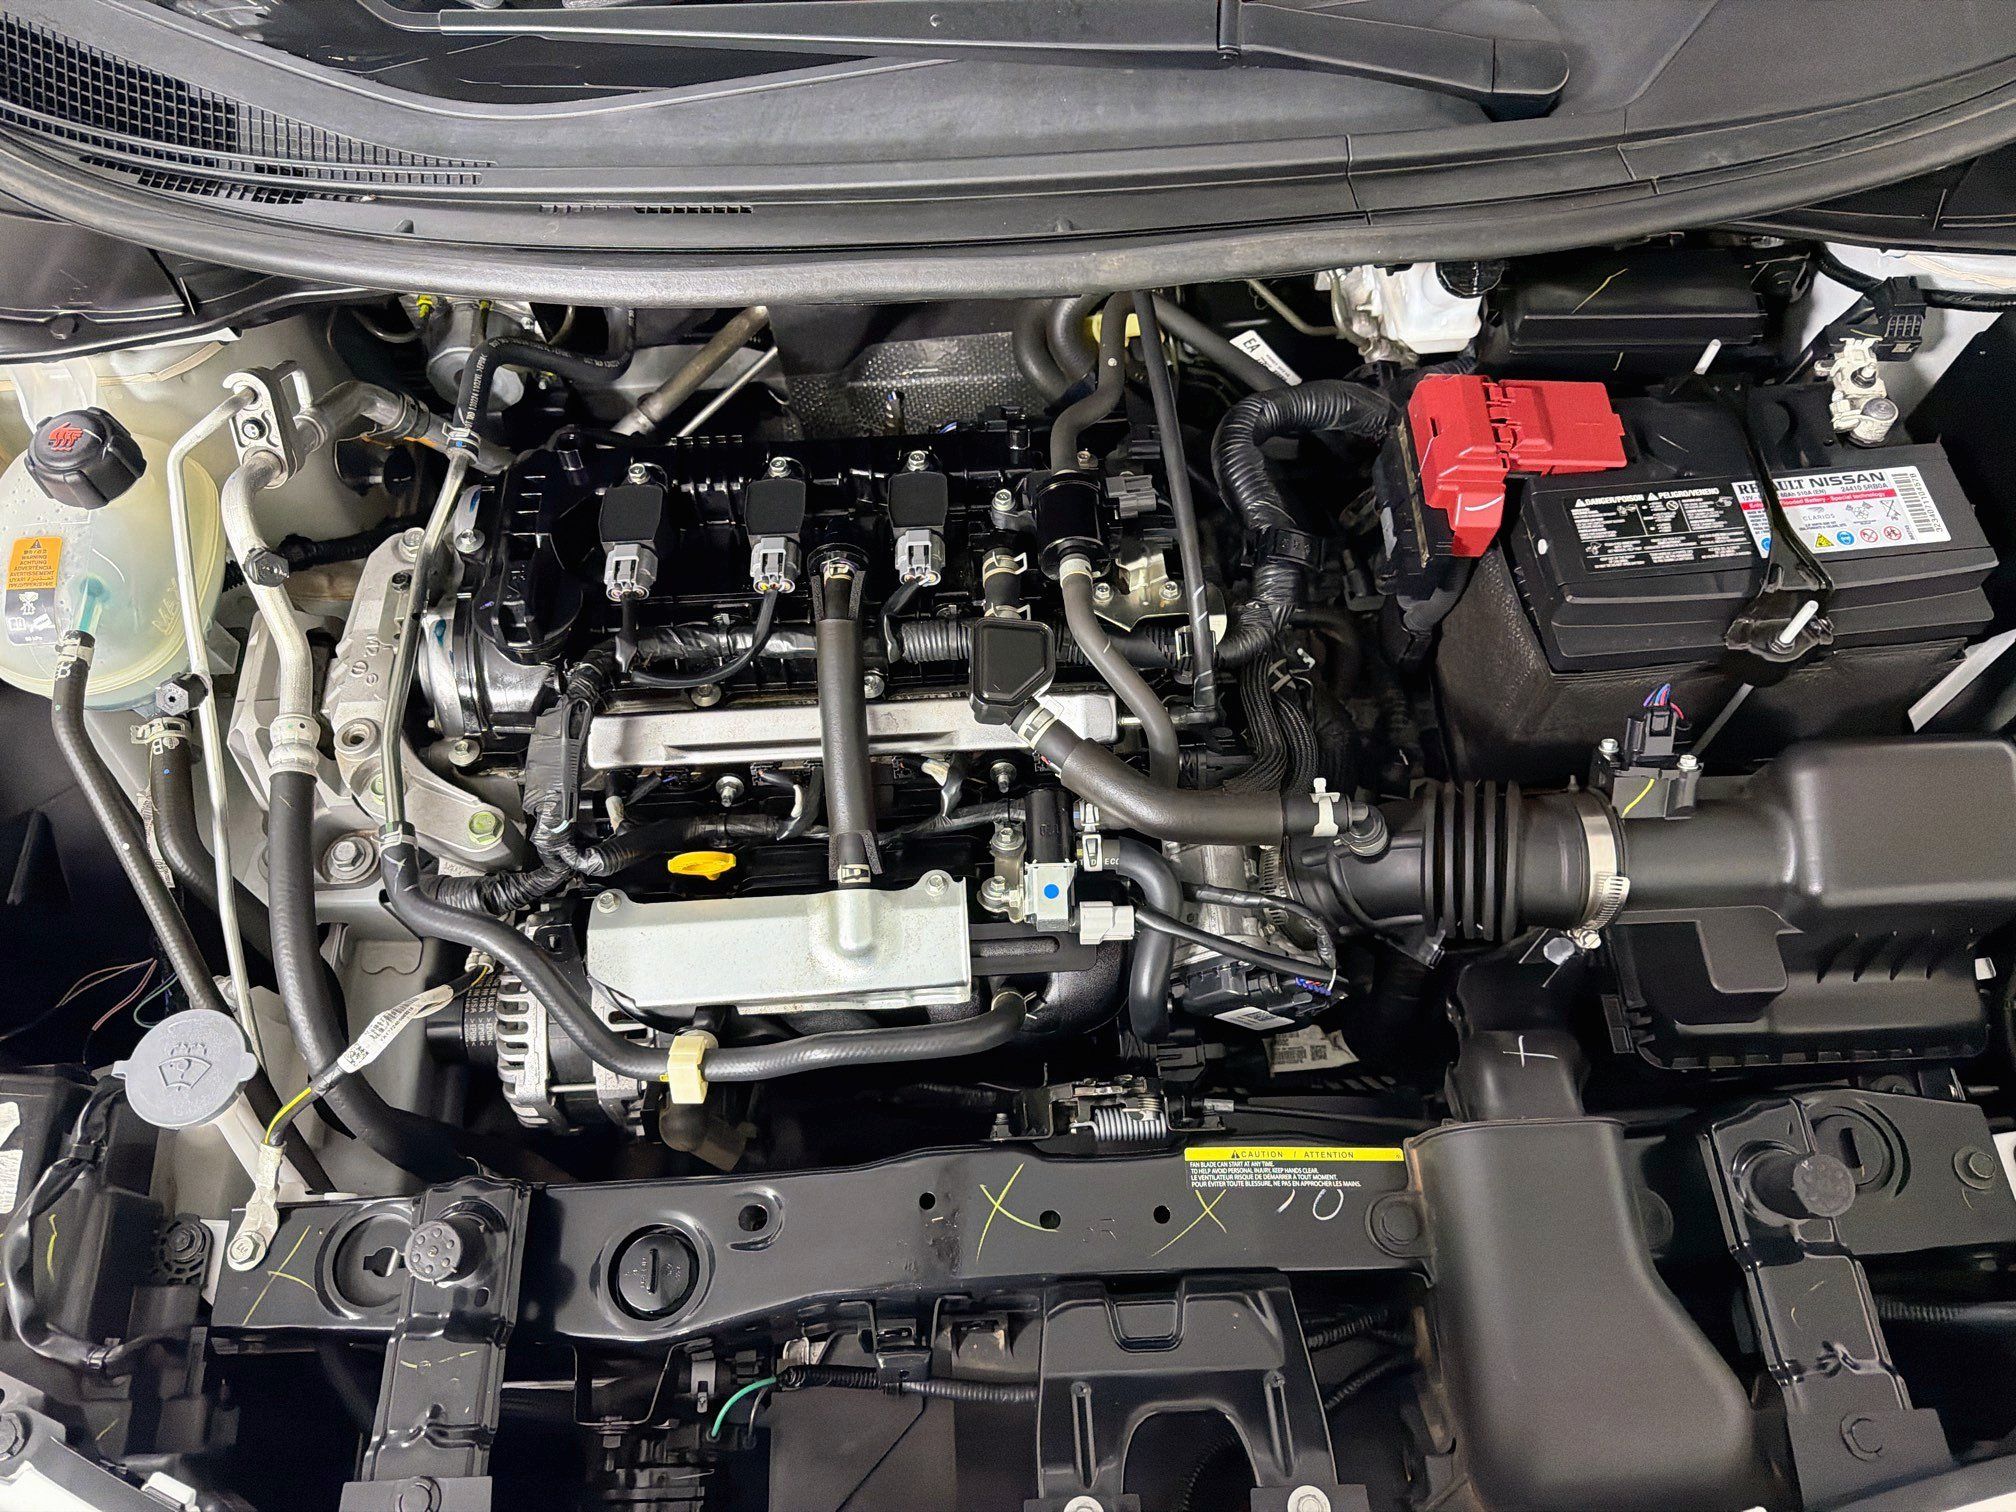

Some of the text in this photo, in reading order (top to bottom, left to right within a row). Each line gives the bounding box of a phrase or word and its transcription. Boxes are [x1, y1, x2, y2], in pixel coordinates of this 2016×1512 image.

[1243, 338, 1261, 353] EA
[1809, 471, 1886, 488] NISSAN
[1658, 487, 1721, 499] PELIGRO/VENENO
[1830, 493, 1853, 503] Special
[1853, 490, 1886, 501] technology
[1584, 494, 1645, 506] DANGER/POISON
[1802, 513, 1836, 521] CLARIOS
